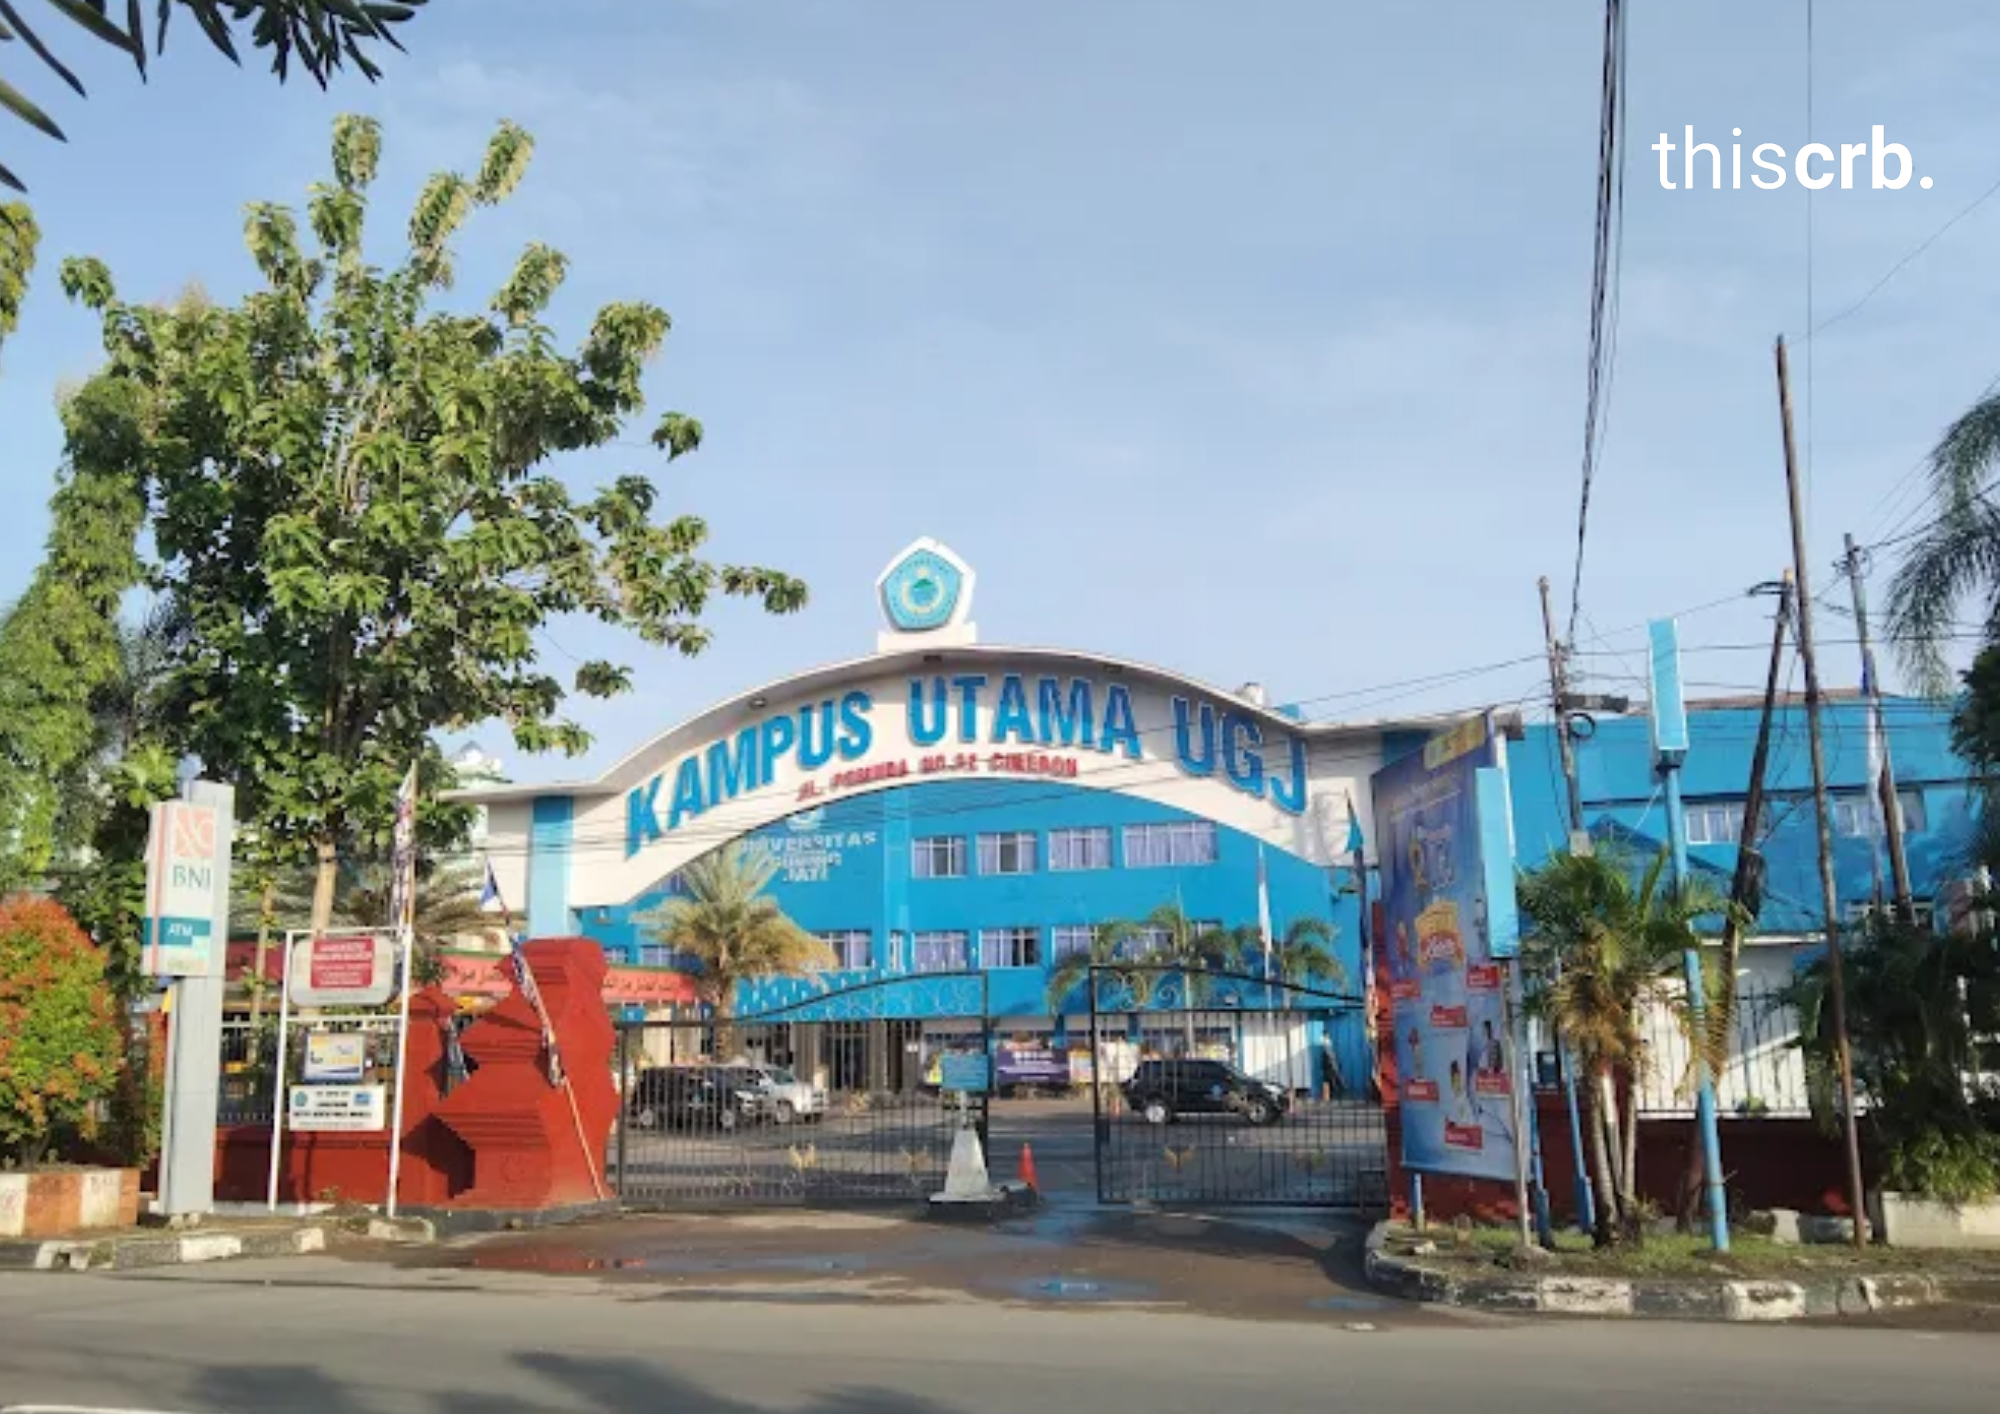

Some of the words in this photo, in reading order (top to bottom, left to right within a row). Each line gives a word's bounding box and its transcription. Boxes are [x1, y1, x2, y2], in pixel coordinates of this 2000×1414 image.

[624, 690, 875, 858] KAMPUS
[906, 673, 1142, 759] UTAMA
[1172, 697, 1308, 815] UGJ
[172, 865, 212, 892] BNI
[167, 923, 193, 936] ATM
